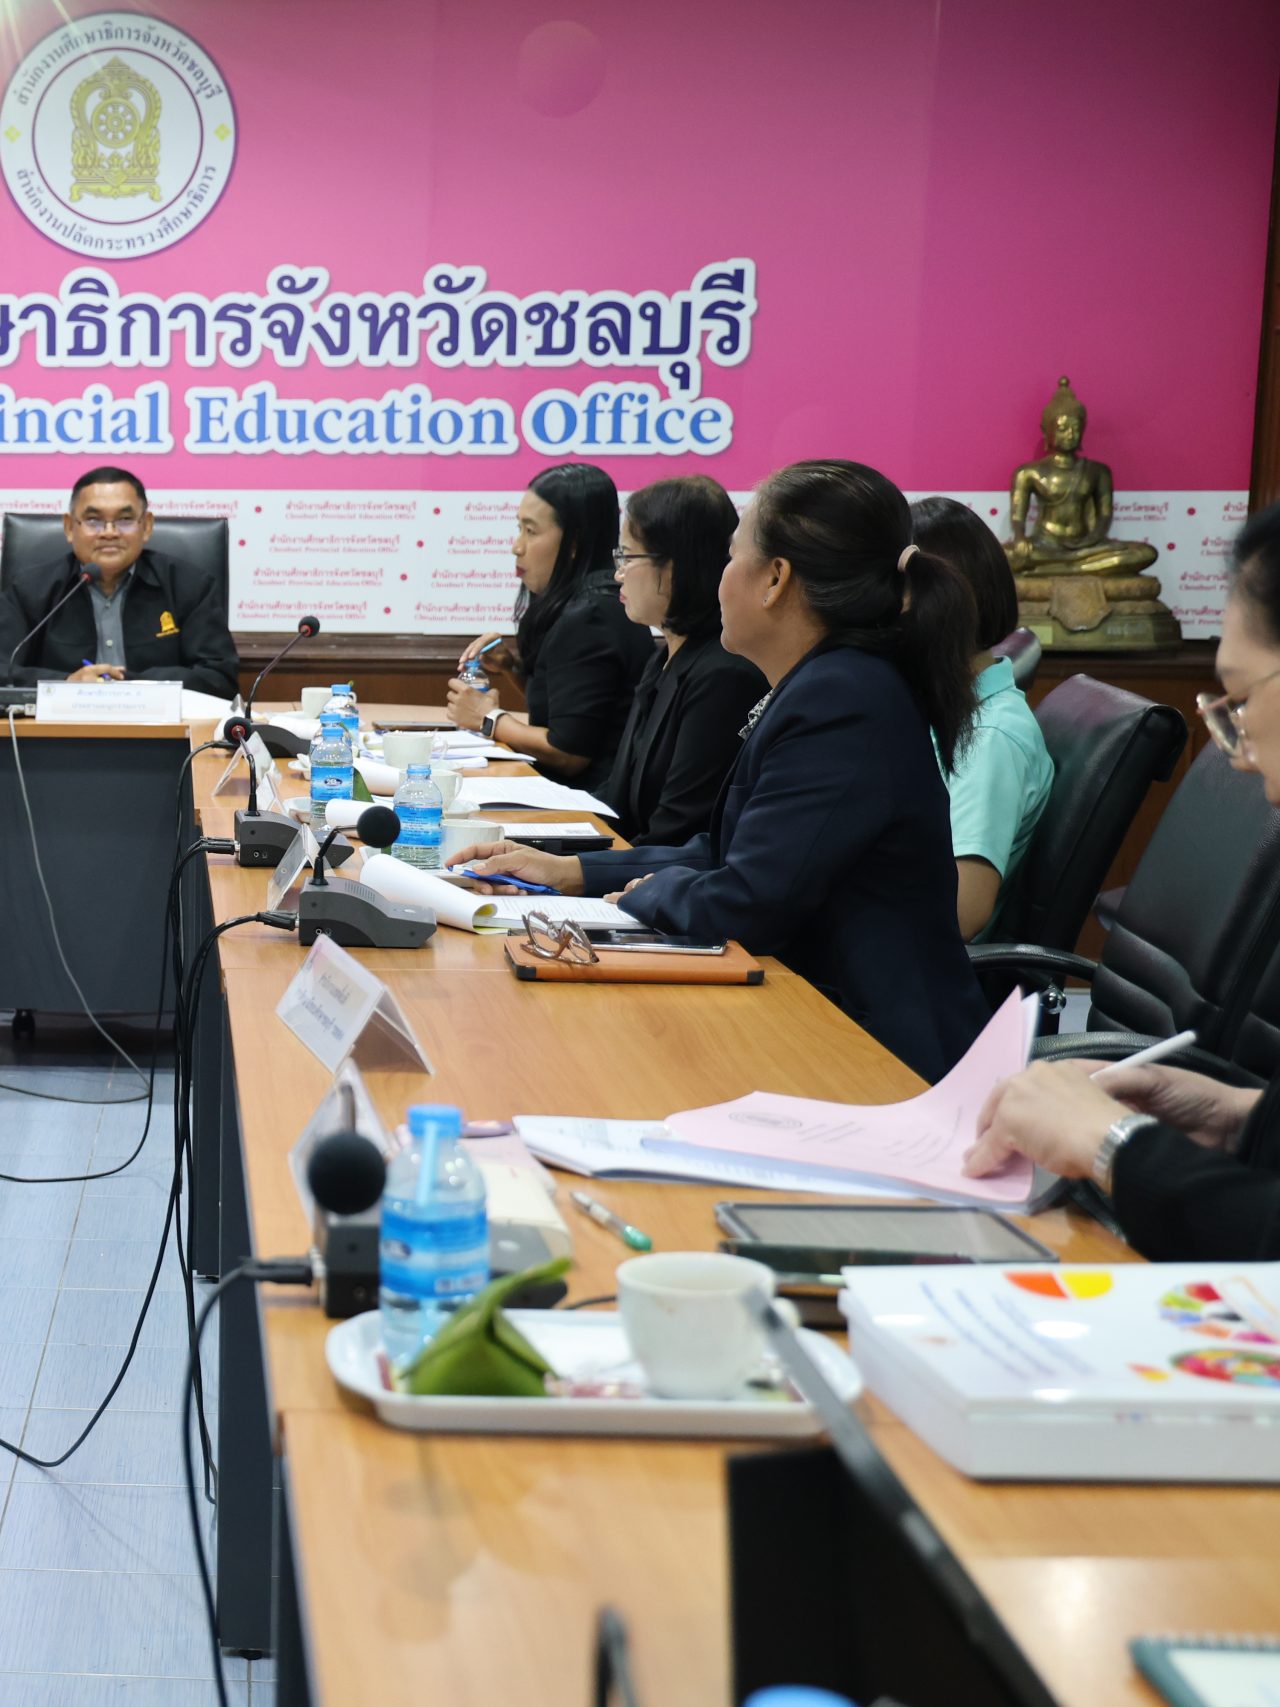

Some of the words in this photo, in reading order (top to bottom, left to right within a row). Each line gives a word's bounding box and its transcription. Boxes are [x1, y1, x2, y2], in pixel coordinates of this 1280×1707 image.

[17, 165, 217, 251] สำนักงานปลัดกระทรวงศึกษาธิการ
[194, 393, 509, 445] Education
[531, 392, 723, 446] Office
